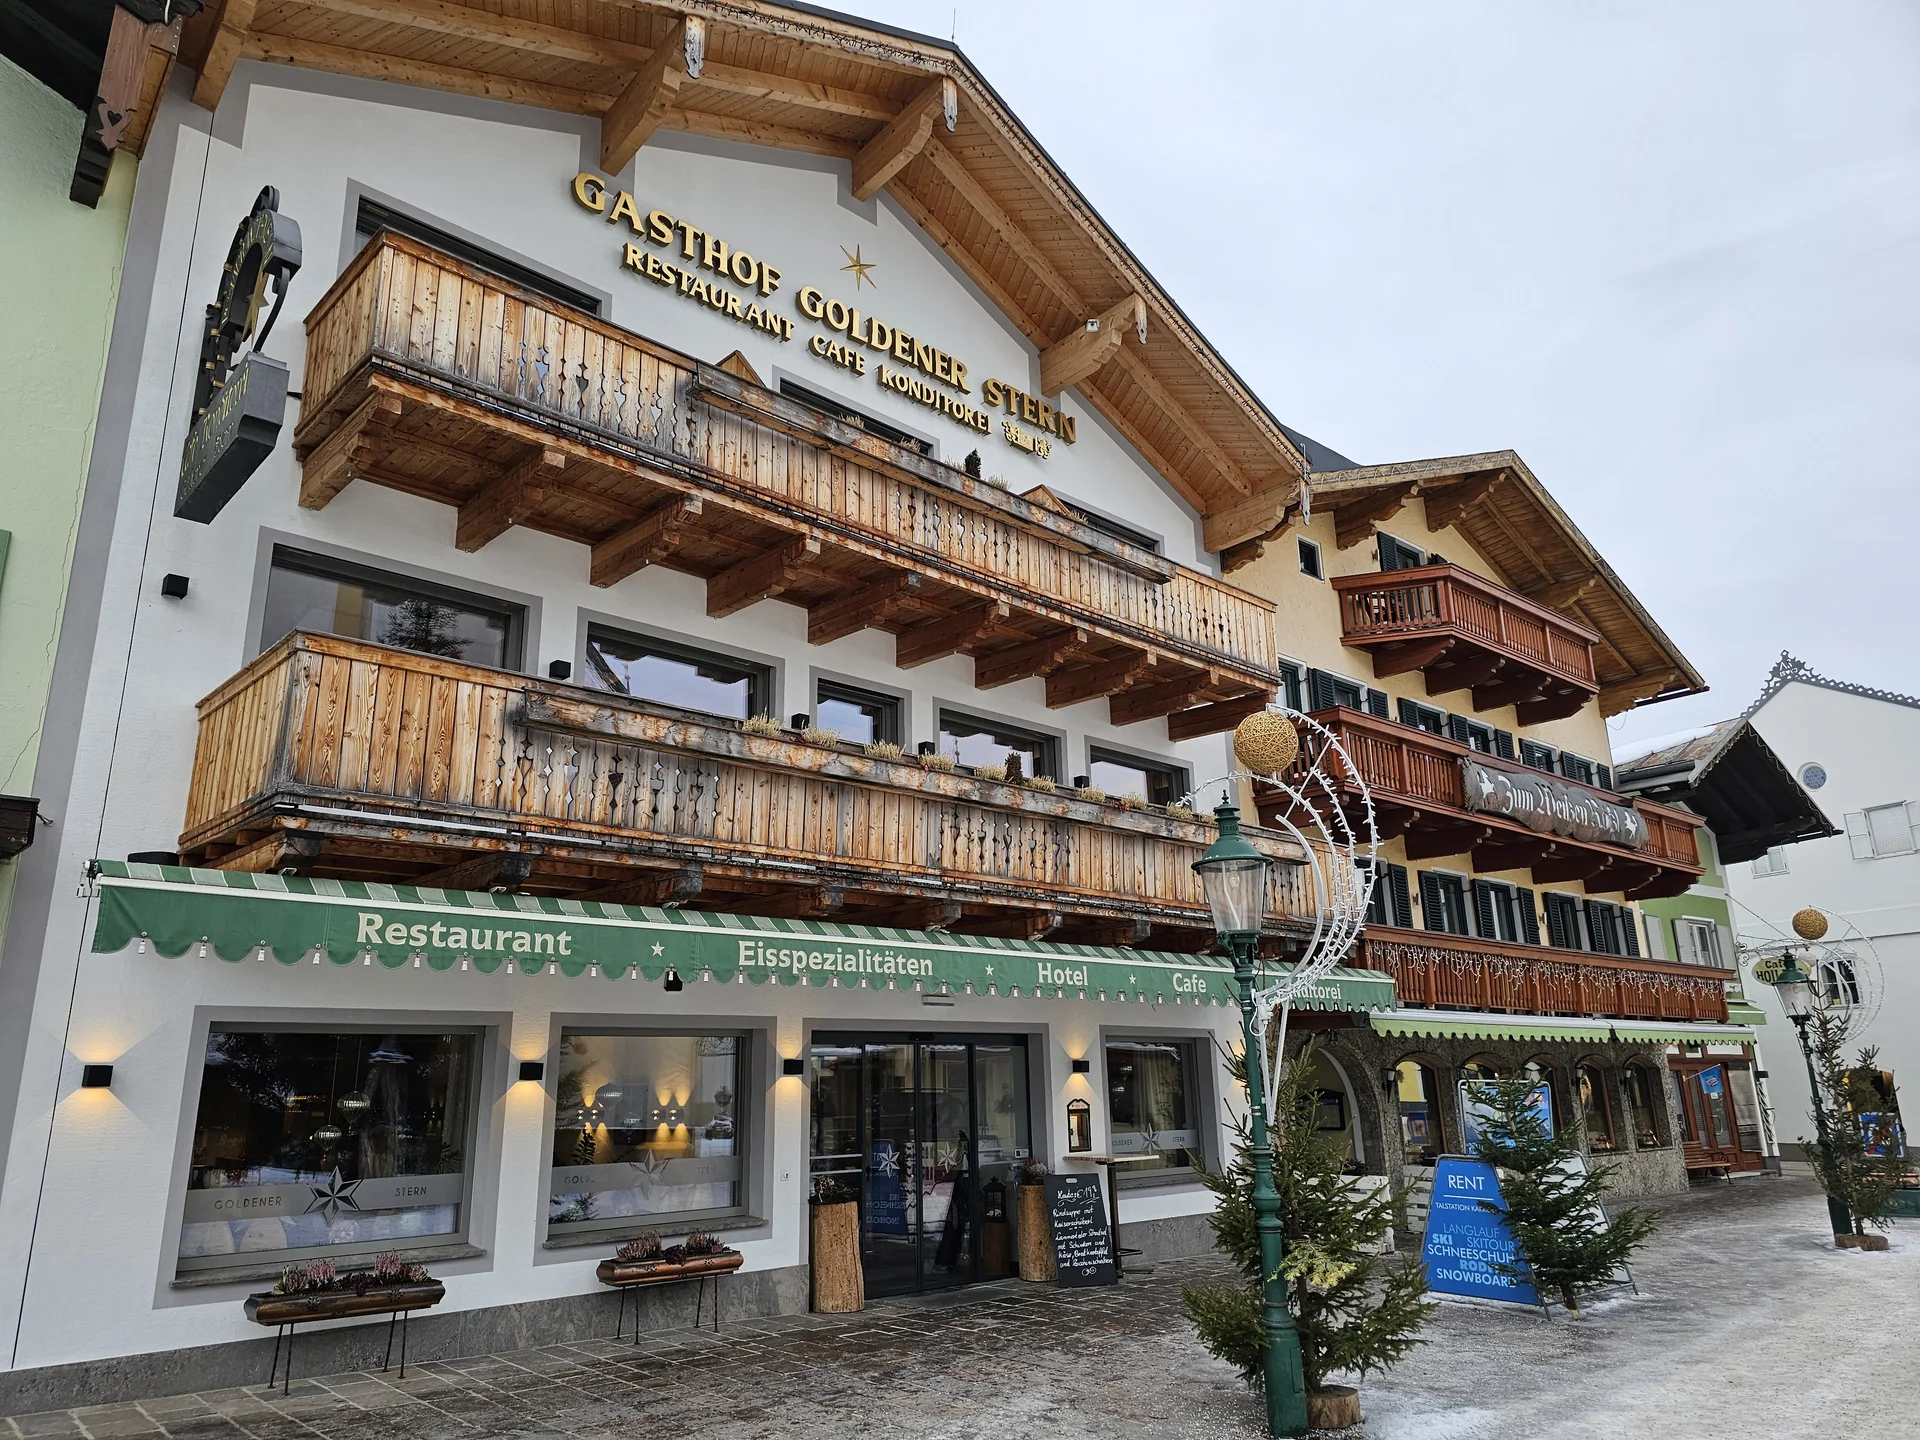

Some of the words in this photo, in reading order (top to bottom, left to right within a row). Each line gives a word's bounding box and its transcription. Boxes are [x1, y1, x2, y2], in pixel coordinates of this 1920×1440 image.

[571, 172, 783, 298] GASTHOF
[796, 286, 972, 395] GOLDENER
[983, 378, 1077, 445] STERN
[622, 242, 795, 342] RESTAURANT
[808, 333, 867, 377] CAFE
[877, 364, 992, 436] KONDITOREI
[1497, 775, 1534, 813] Zum
[357, 911, 573, 956] Restaurant
[738, 940, 934, 976] Eisspezialitäten
[1038, 962, 1088, 986] Hotel
[1172, 972, 1207, 994] Cafe
[1765, 959, 1786, 968] Caf
[1447, 1174, 1485, 1191] RENT
[214, 1196, 283, 1210] GOLDENER
[395, 1186, 428, 1197] STERN
[1435, 1202, 1470, 1211] TALSTATION
[1443, 1223, 1500, 1238] LANGLAUF
[1432, 1233, 1453, 1245] SKI
[1467, 1236, 1515, 1252] SKITOUR
[1428, 1244, 1515, 1264] SCHNEESCHUH
